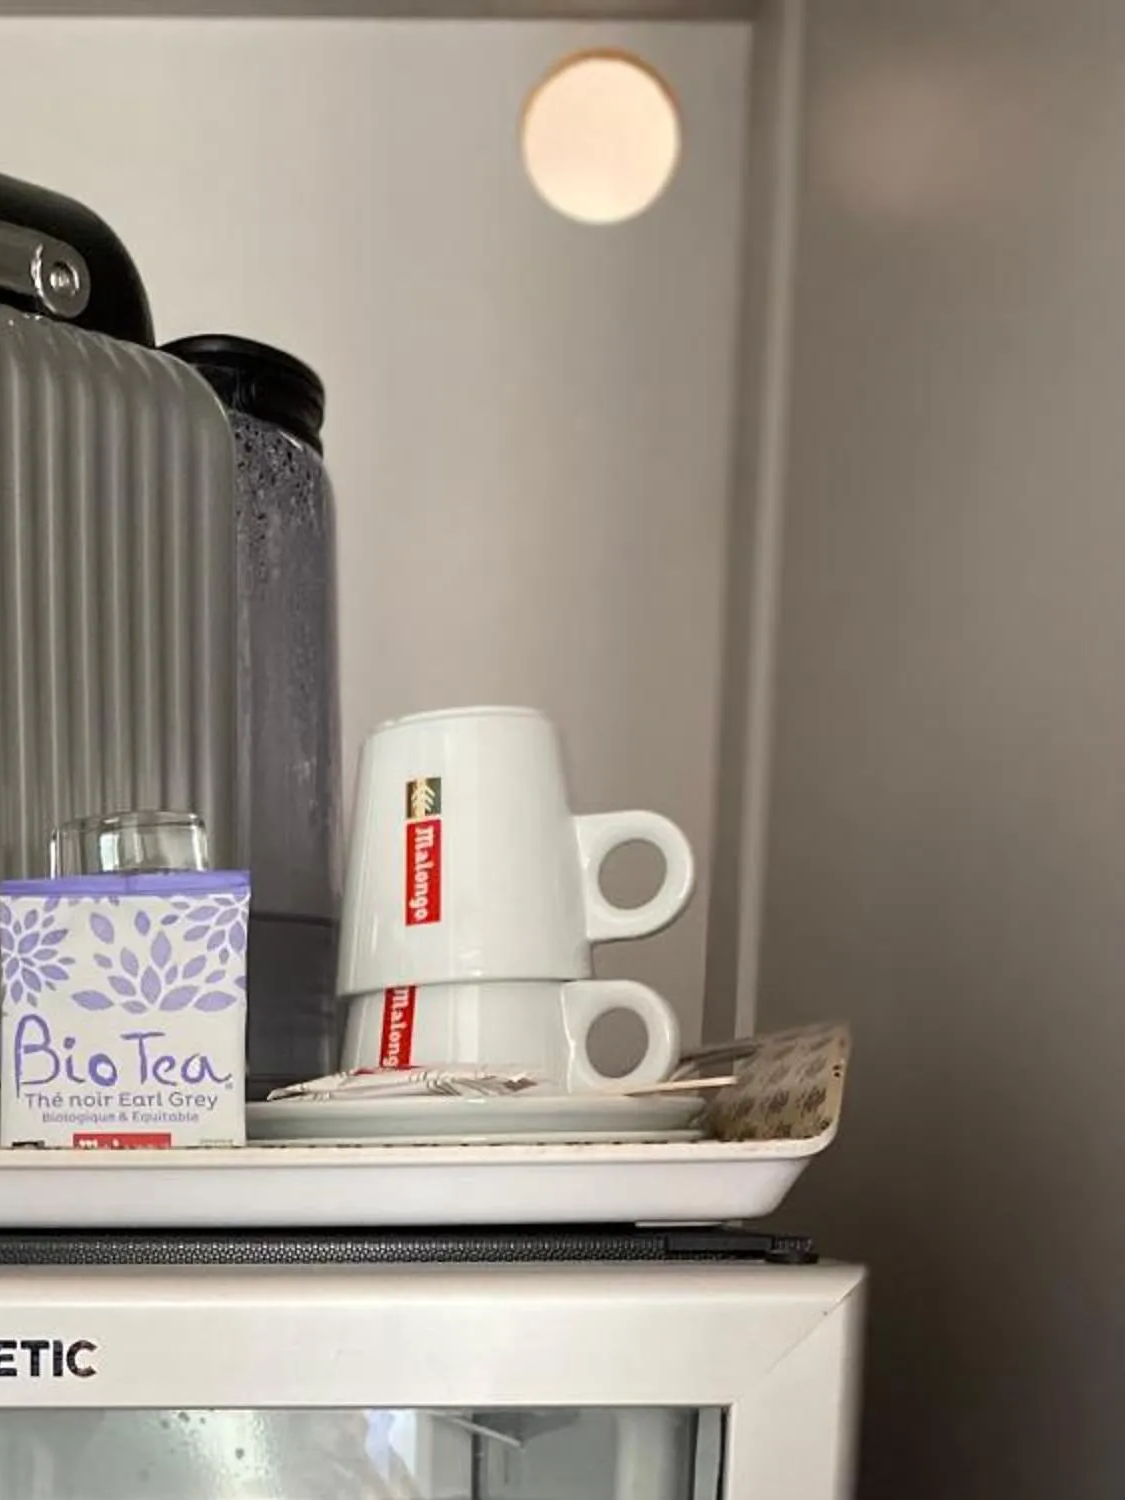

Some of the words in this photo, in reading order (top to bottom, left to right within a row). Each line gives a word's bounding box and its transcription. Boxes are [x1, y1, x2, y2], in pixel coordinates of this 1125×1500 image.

[409, 826, 434, 921] Malongo
[13, 1014, 118, 1098] Bio
[121, 1032, 230, 1087] Tea
[383, 987, 410, 1068] Malong
[25, 1092, 63, 1108] Thé
[70, 1093, 113, 1108] noir
[119, 1091, 162, 1107] Earl
[168, 1091, 219, 1110] Grey
